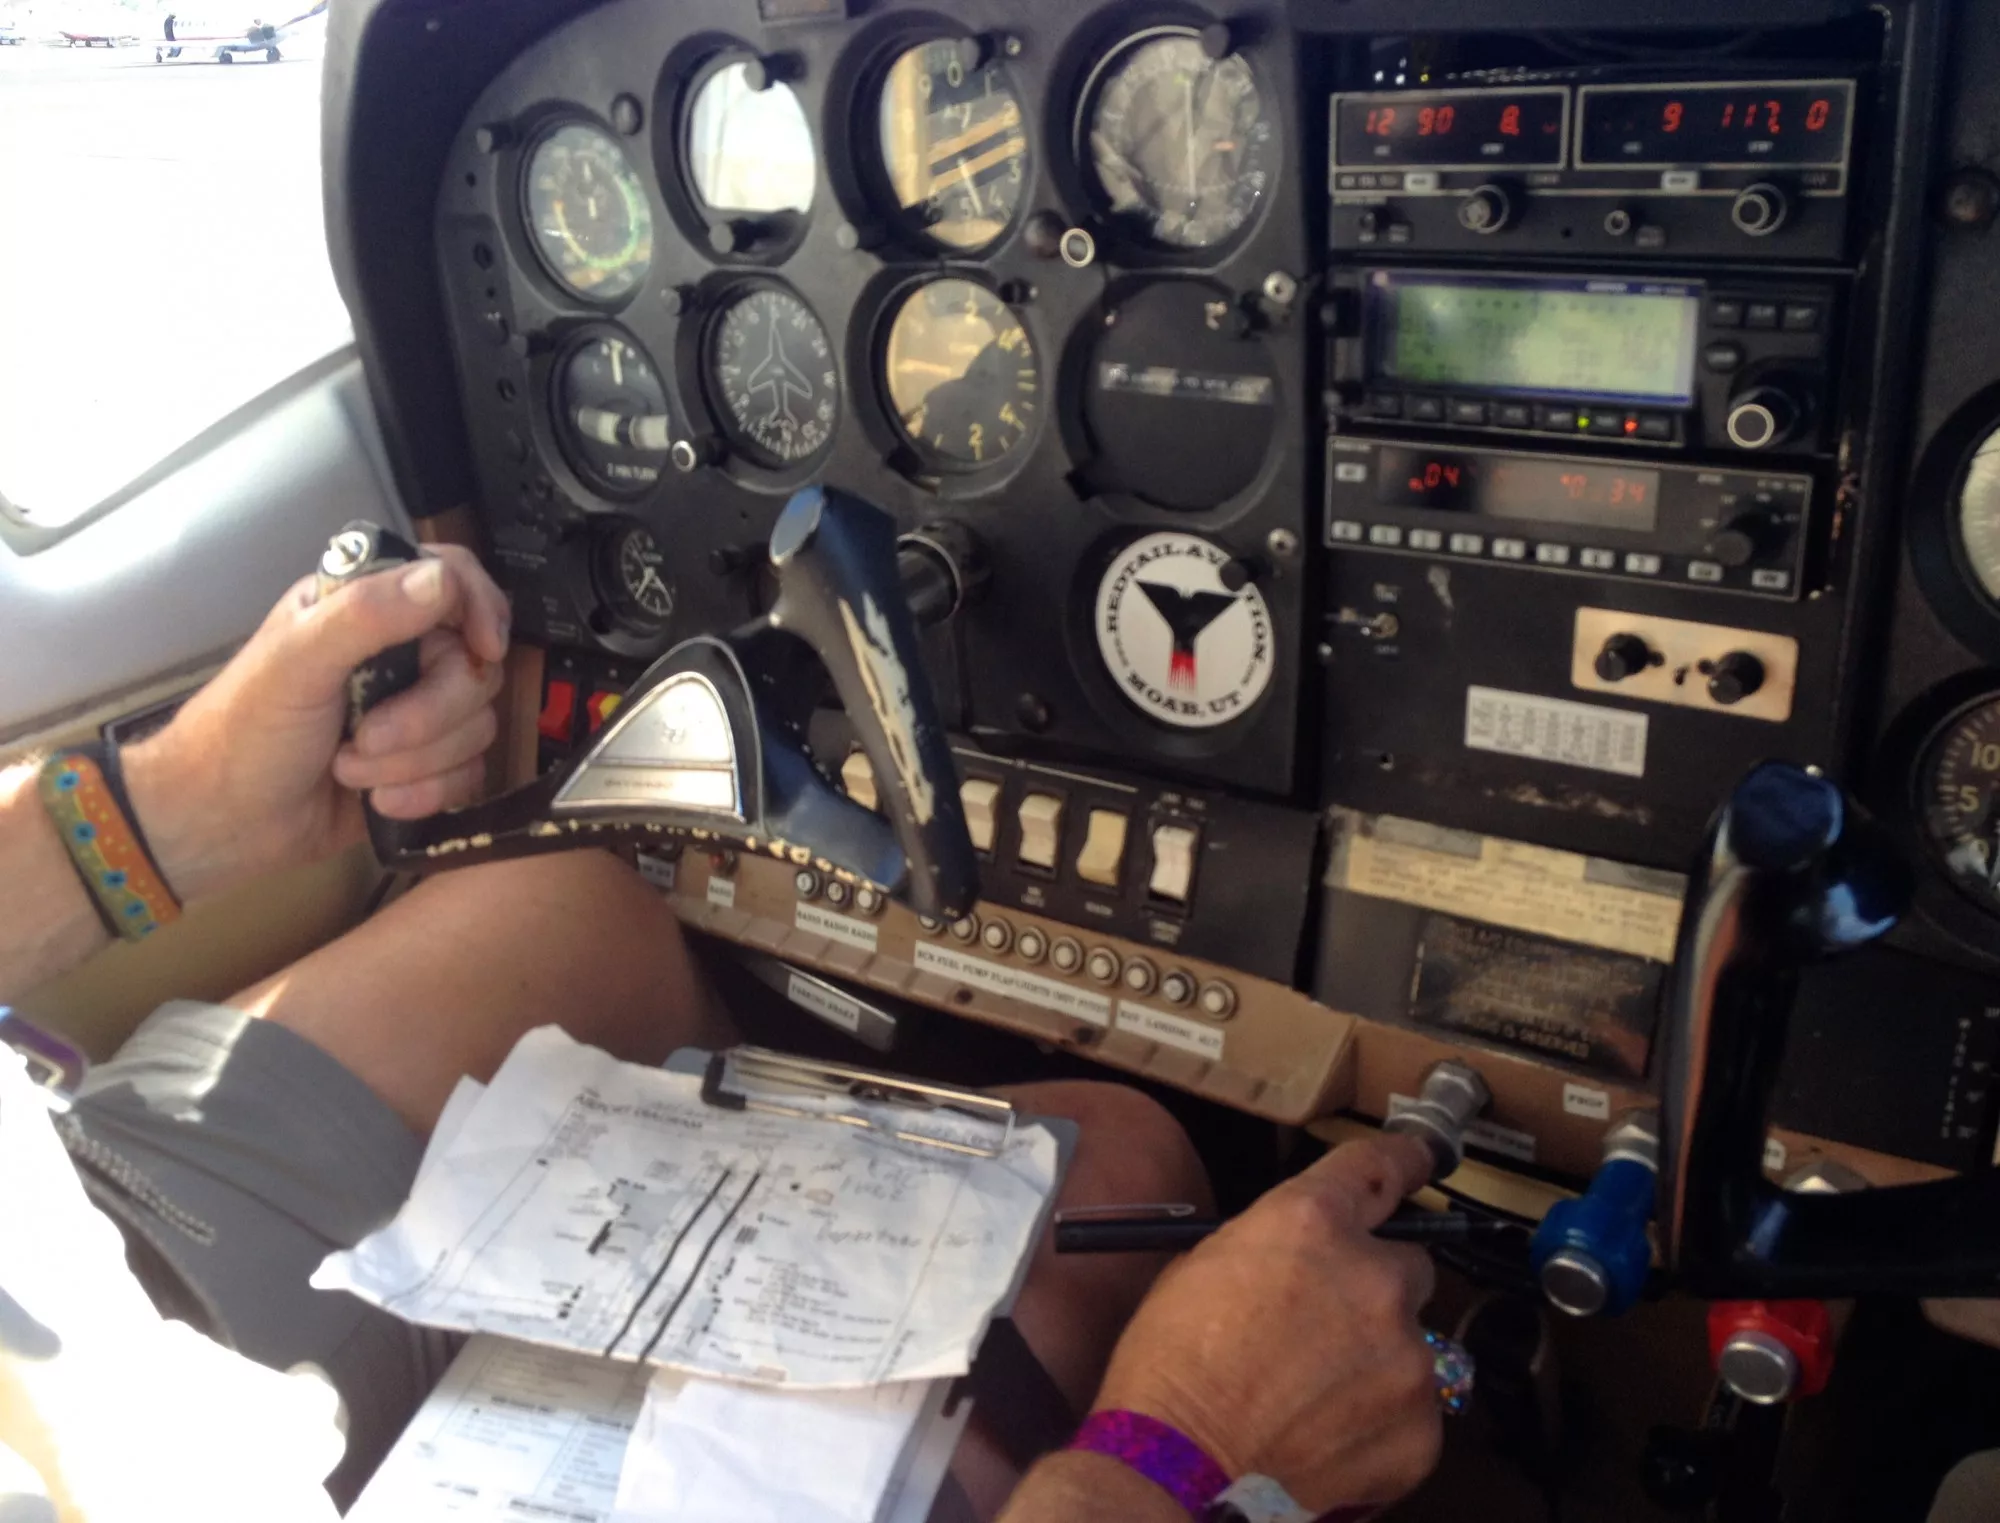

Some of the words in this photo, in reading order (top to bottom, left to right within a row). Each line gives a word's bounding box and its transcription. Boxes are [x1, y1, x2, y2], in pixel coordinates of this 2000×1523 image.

[1106, 542, 1179, 634] REDTAIL
[1207, 690, 1242, 715] UT
[1956, 784, 1980, 813] 5
